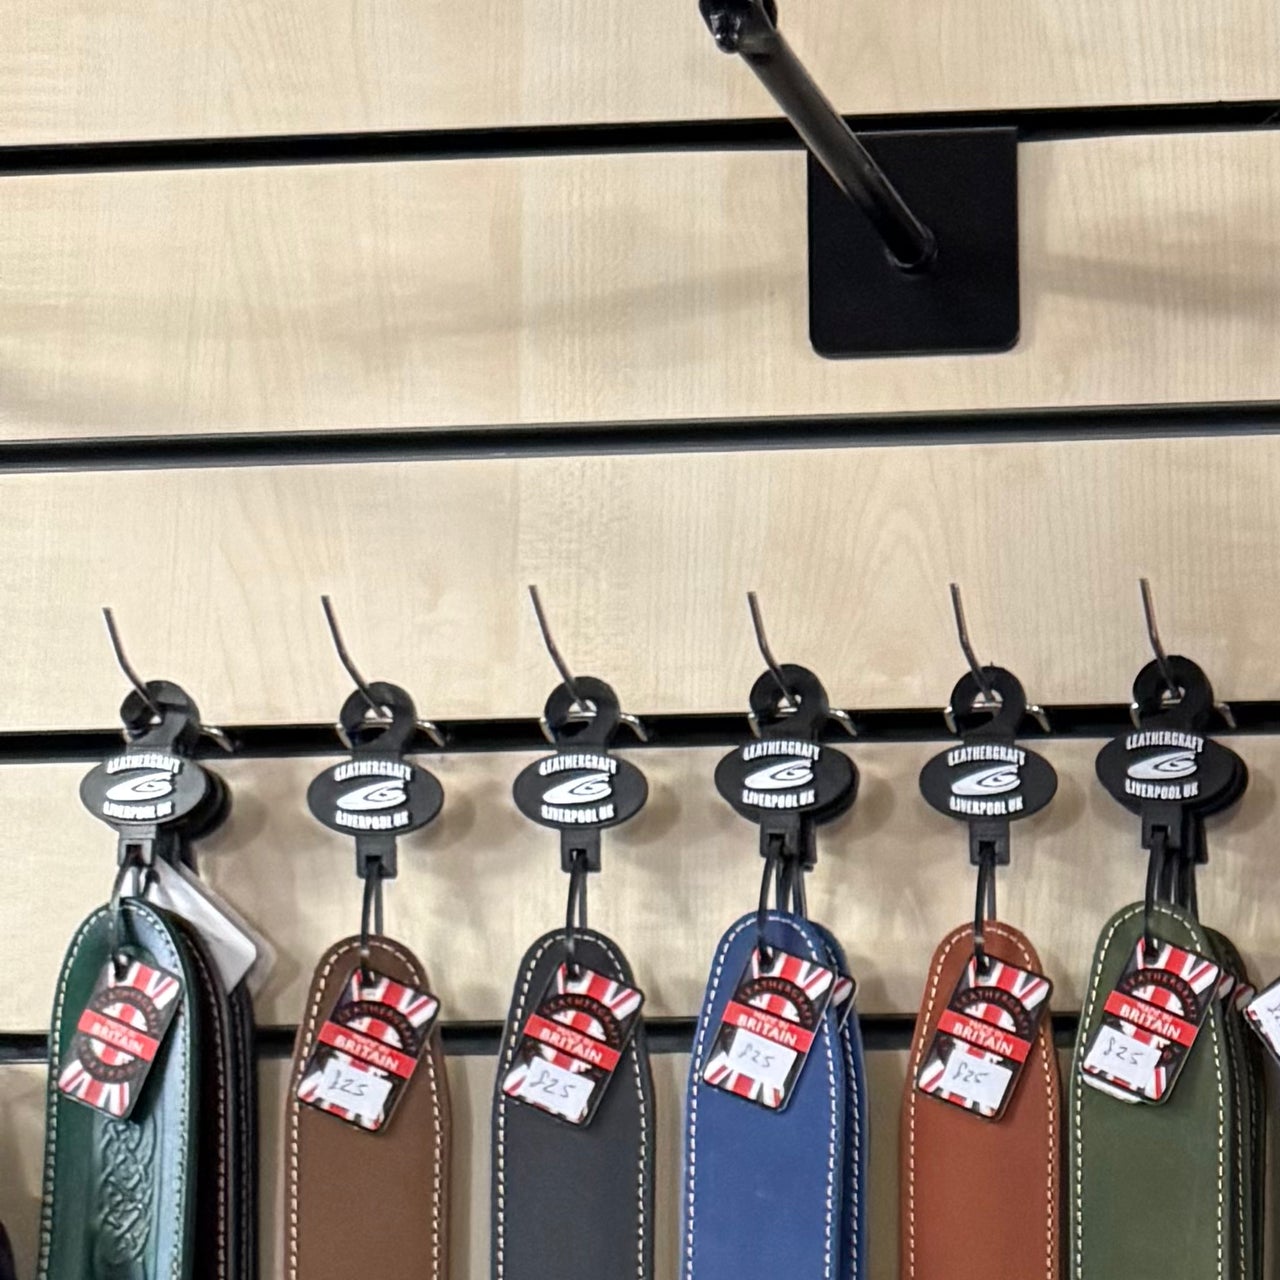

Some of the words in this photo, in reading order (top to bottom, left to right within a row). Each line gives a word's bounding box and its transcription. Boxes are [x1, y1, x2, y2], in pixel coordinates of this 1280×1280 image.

[742, 789, 798, 808] LIVERPOOL
[799, 789, 815, 805] UK
[1125, 778, 1182, 799] LIVERPOOL
[1183, 782, 1198, 798] UK
[949, 796, 1007, 815] LIVERPOOL
[1008, 796, 1023, 812] UK
[737, 1014, 797, 1047] BRITAIN
[1119, 1004, 1181, 1039] BRITAIN
[334, 1034, 399, 1069] BRITAIN
[539, 1028, 603, 1063] BRITAIN
[953, 1023, 1014, 1055] BRITAIN
